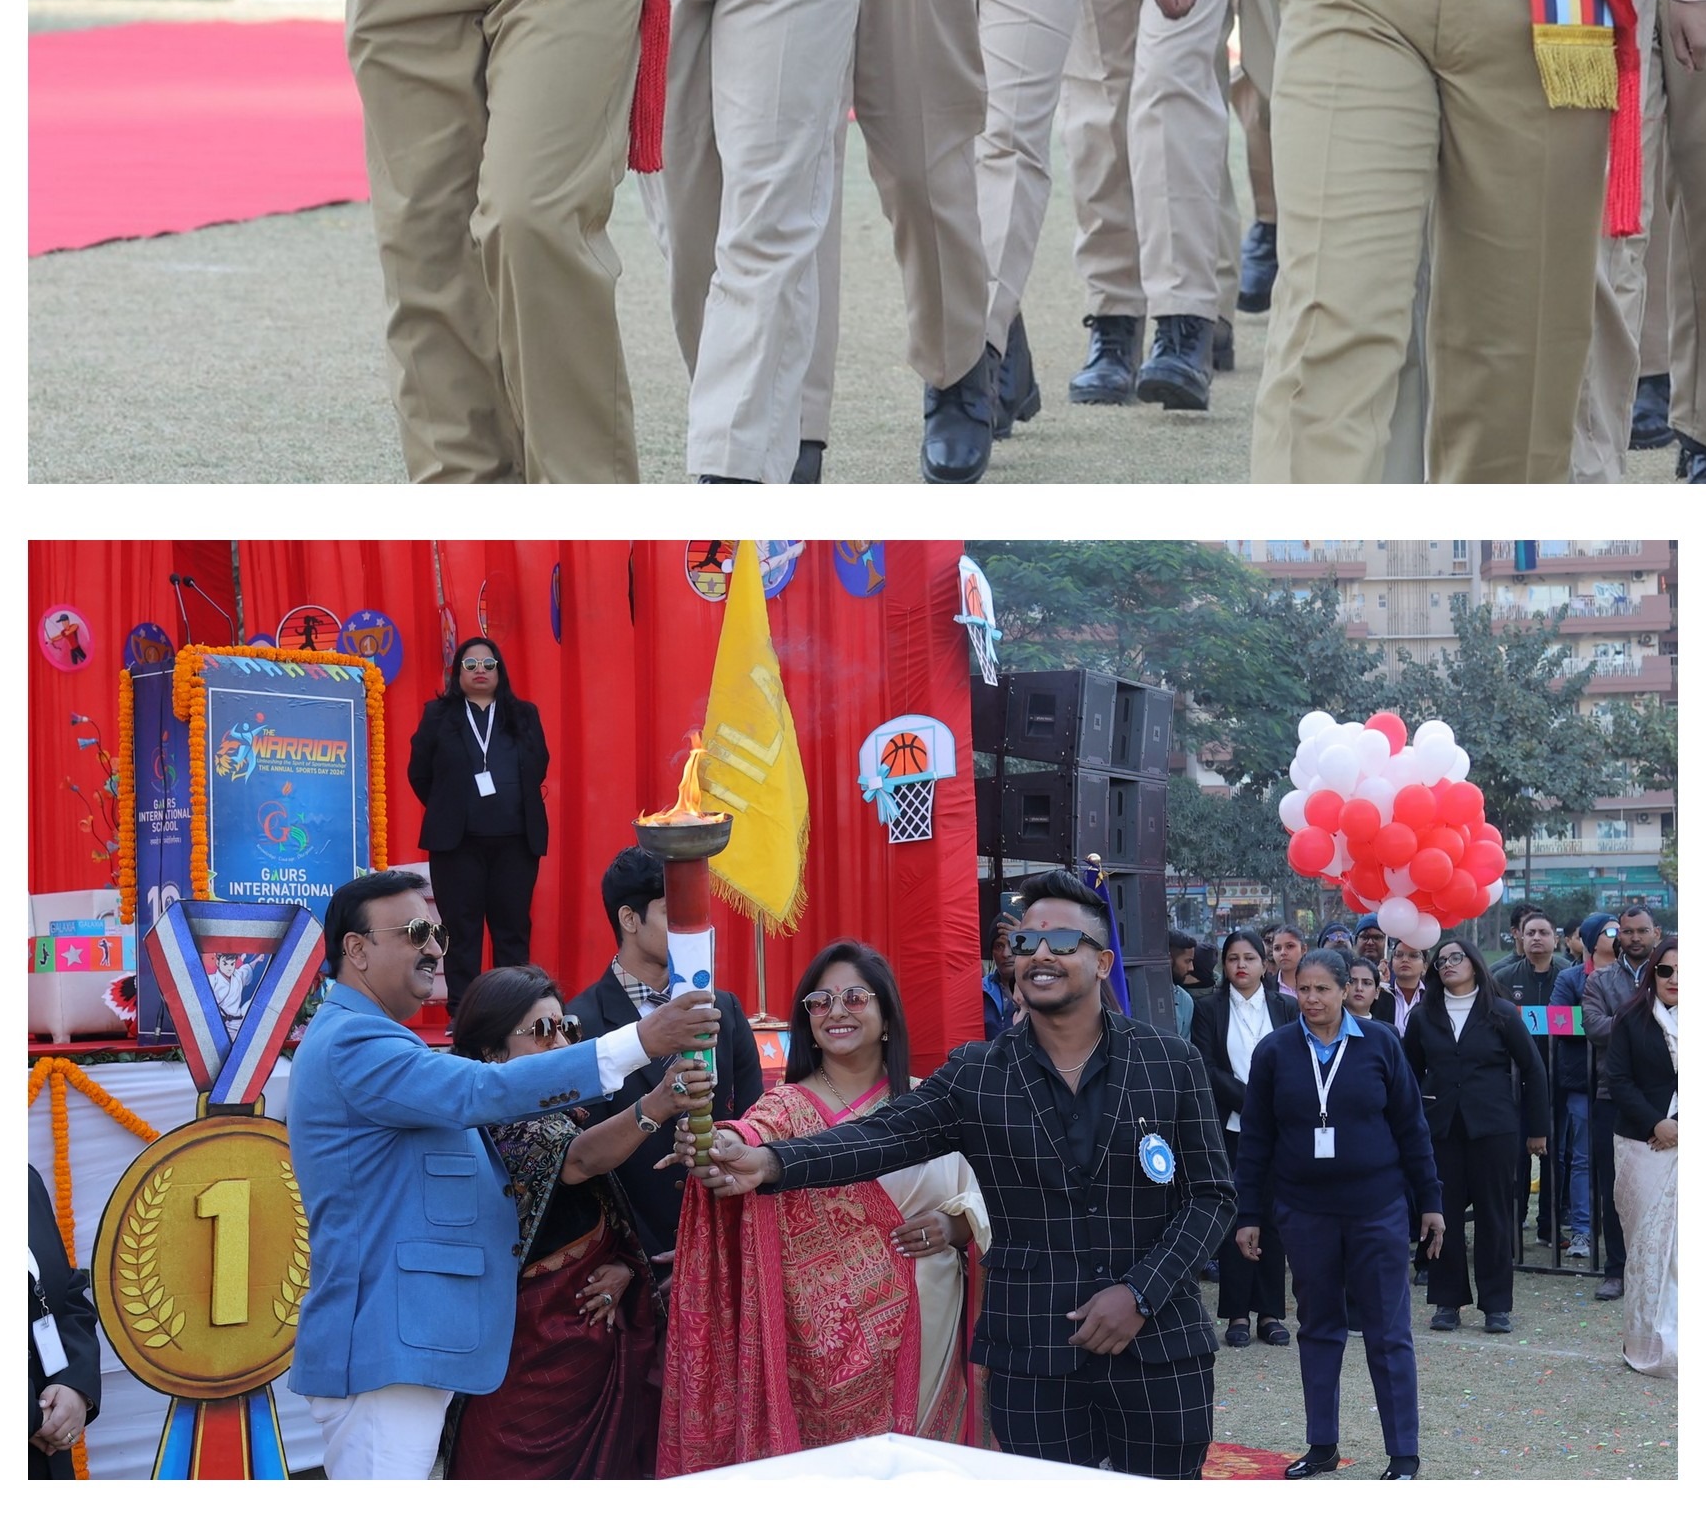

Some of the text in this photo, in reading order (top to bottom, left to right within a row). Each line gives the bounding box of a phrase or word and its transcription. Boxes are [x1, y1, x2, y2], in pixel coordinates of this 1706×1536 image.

[262, 728, 275, 737] THE
[253, 736, 348, 763] WARRIOR
[270, 765, 293, 773] ANNUAL
[295, 766, 317, 774] SPORTS
[261, 867, 307, 882] GAURS
[229, 882, 334, 897] INTERNATIONAL
[51, 920, 103, 934] GALAXIA GALAXIA
[195, 1179, 251, 1325] 1
